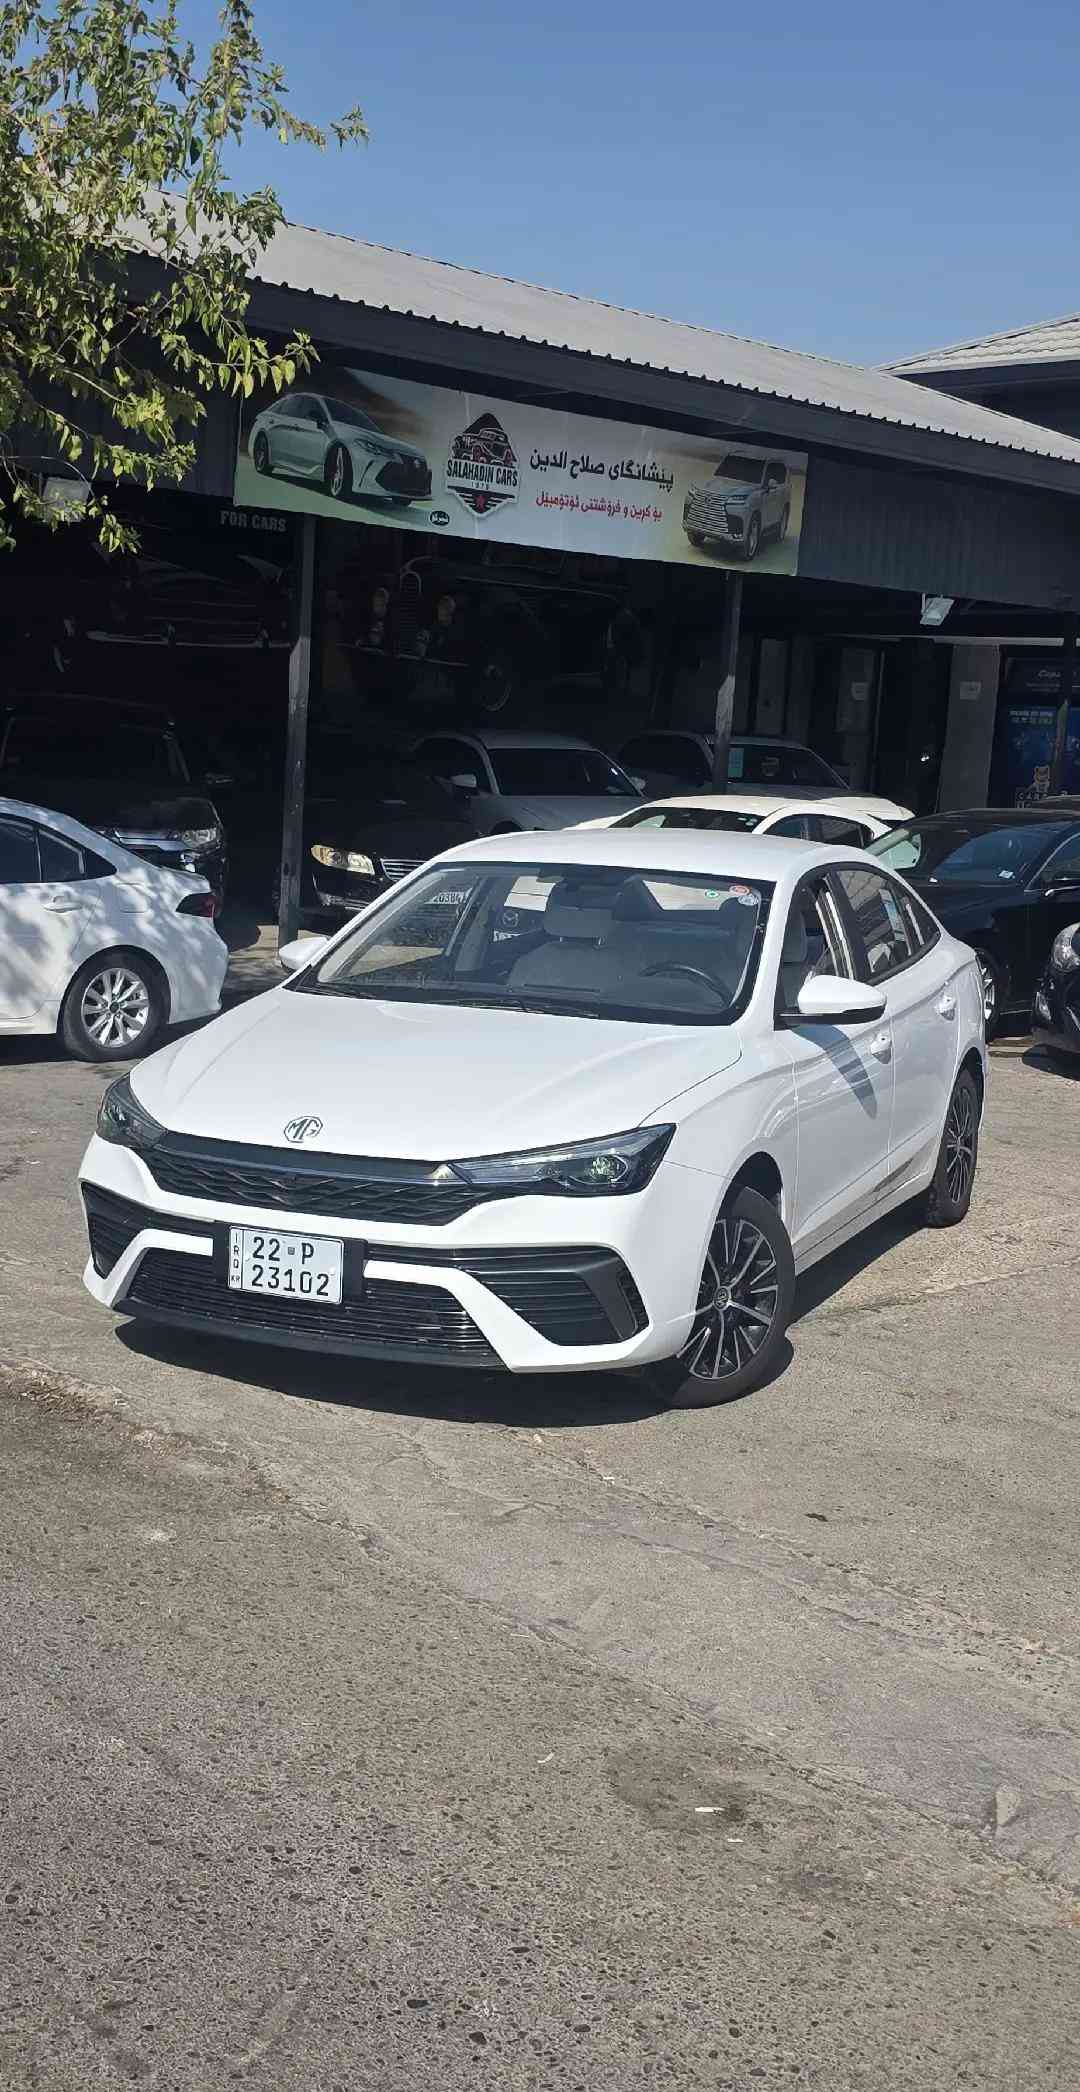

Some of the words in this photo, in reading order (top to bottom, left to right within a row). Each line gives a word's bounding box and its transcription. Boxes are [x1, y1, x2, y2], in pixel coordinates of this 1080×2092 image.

[446, 460, 494, 483] SALAHADIN
[495, 467, 518, 487] CARS
[569, 454, 605, 479] صلاح
[219, 510, 248, 529] FOR
[251, 513, 288, 533] CARS
[286, 1117, 321, 1141] MG
[252, 1236, 281, 1262] 22
[301, 1242, 315, 1265] P
[251, 1264, 329, 1297] 23102
